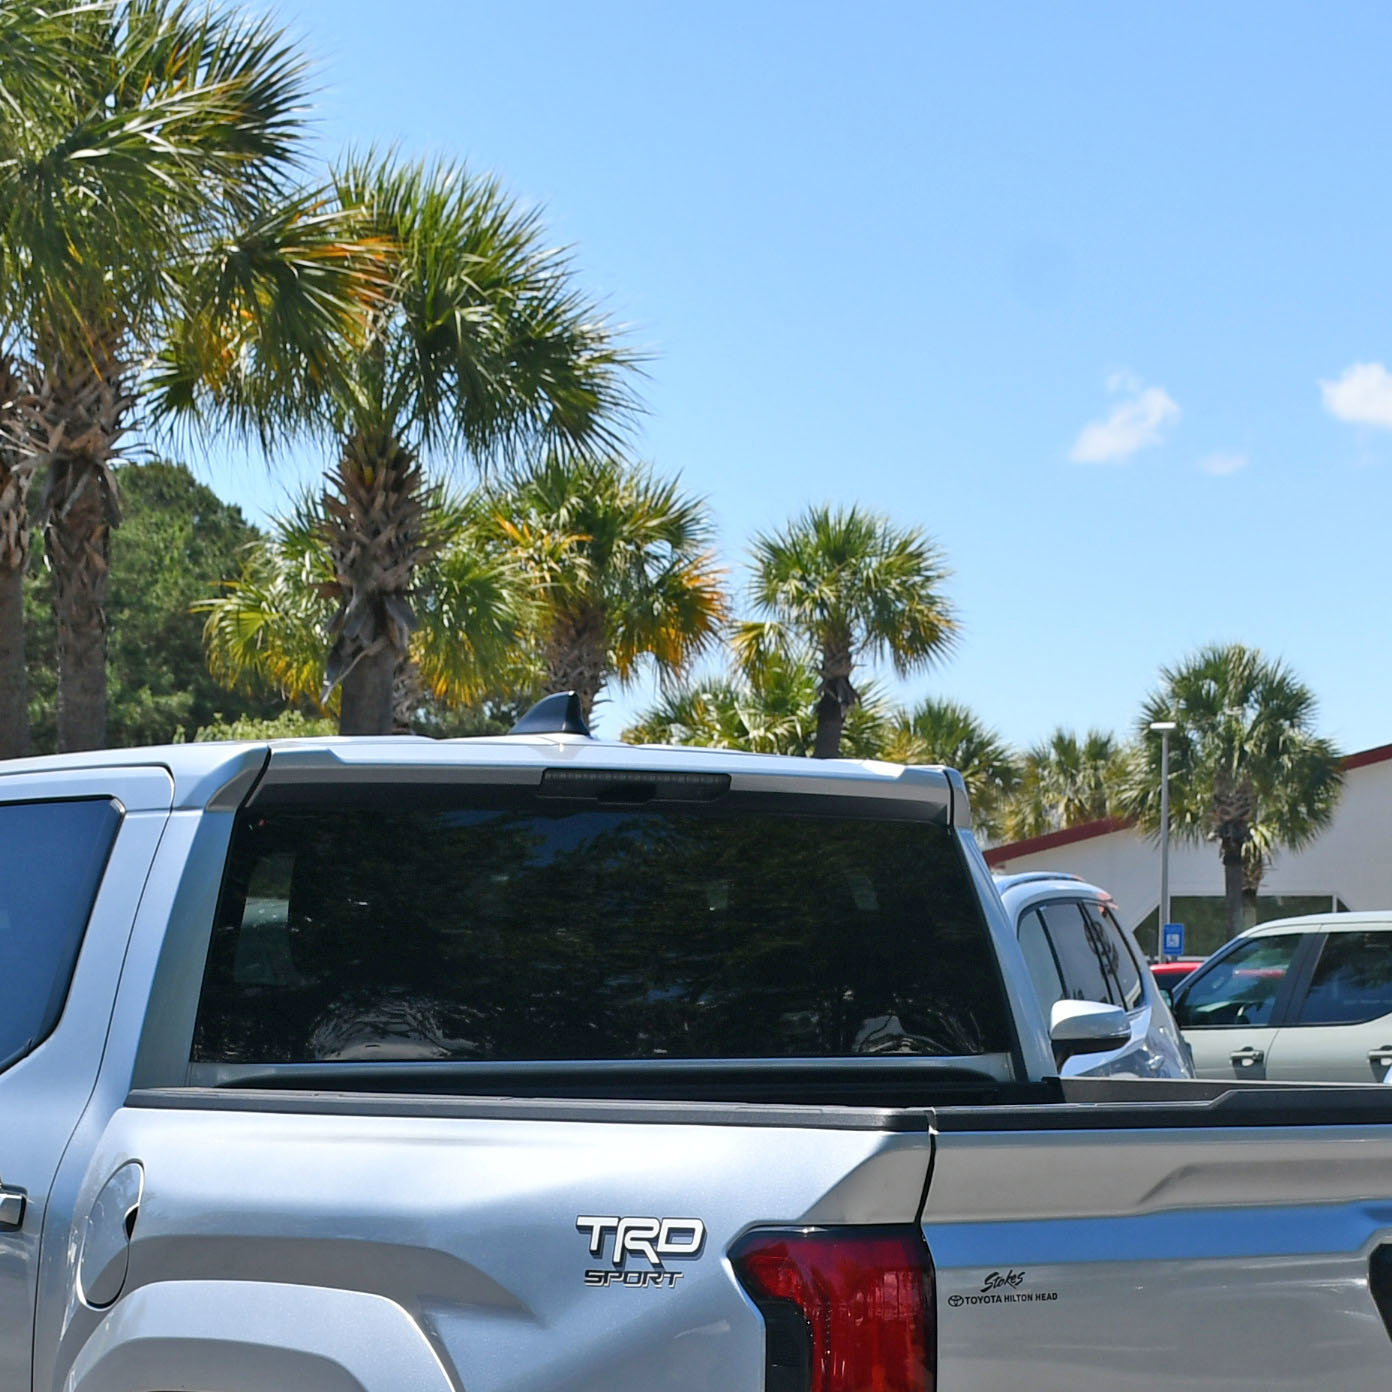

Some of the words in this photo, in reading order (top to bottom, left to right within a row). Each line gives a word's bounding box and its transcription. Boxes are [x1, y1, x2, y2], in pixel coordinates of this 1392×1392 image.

[575, 1214, 707, 1271] TRD
[583, 1269, 685, 1288] SPORT
[980, 1269, 1026, 1293] Stokes
[965, 1294, 1002, 1305] TOYOTA
[1004, 1294, 1033, 1303] HILTON
[1035, 1292, 1058, 1301] HEAD
